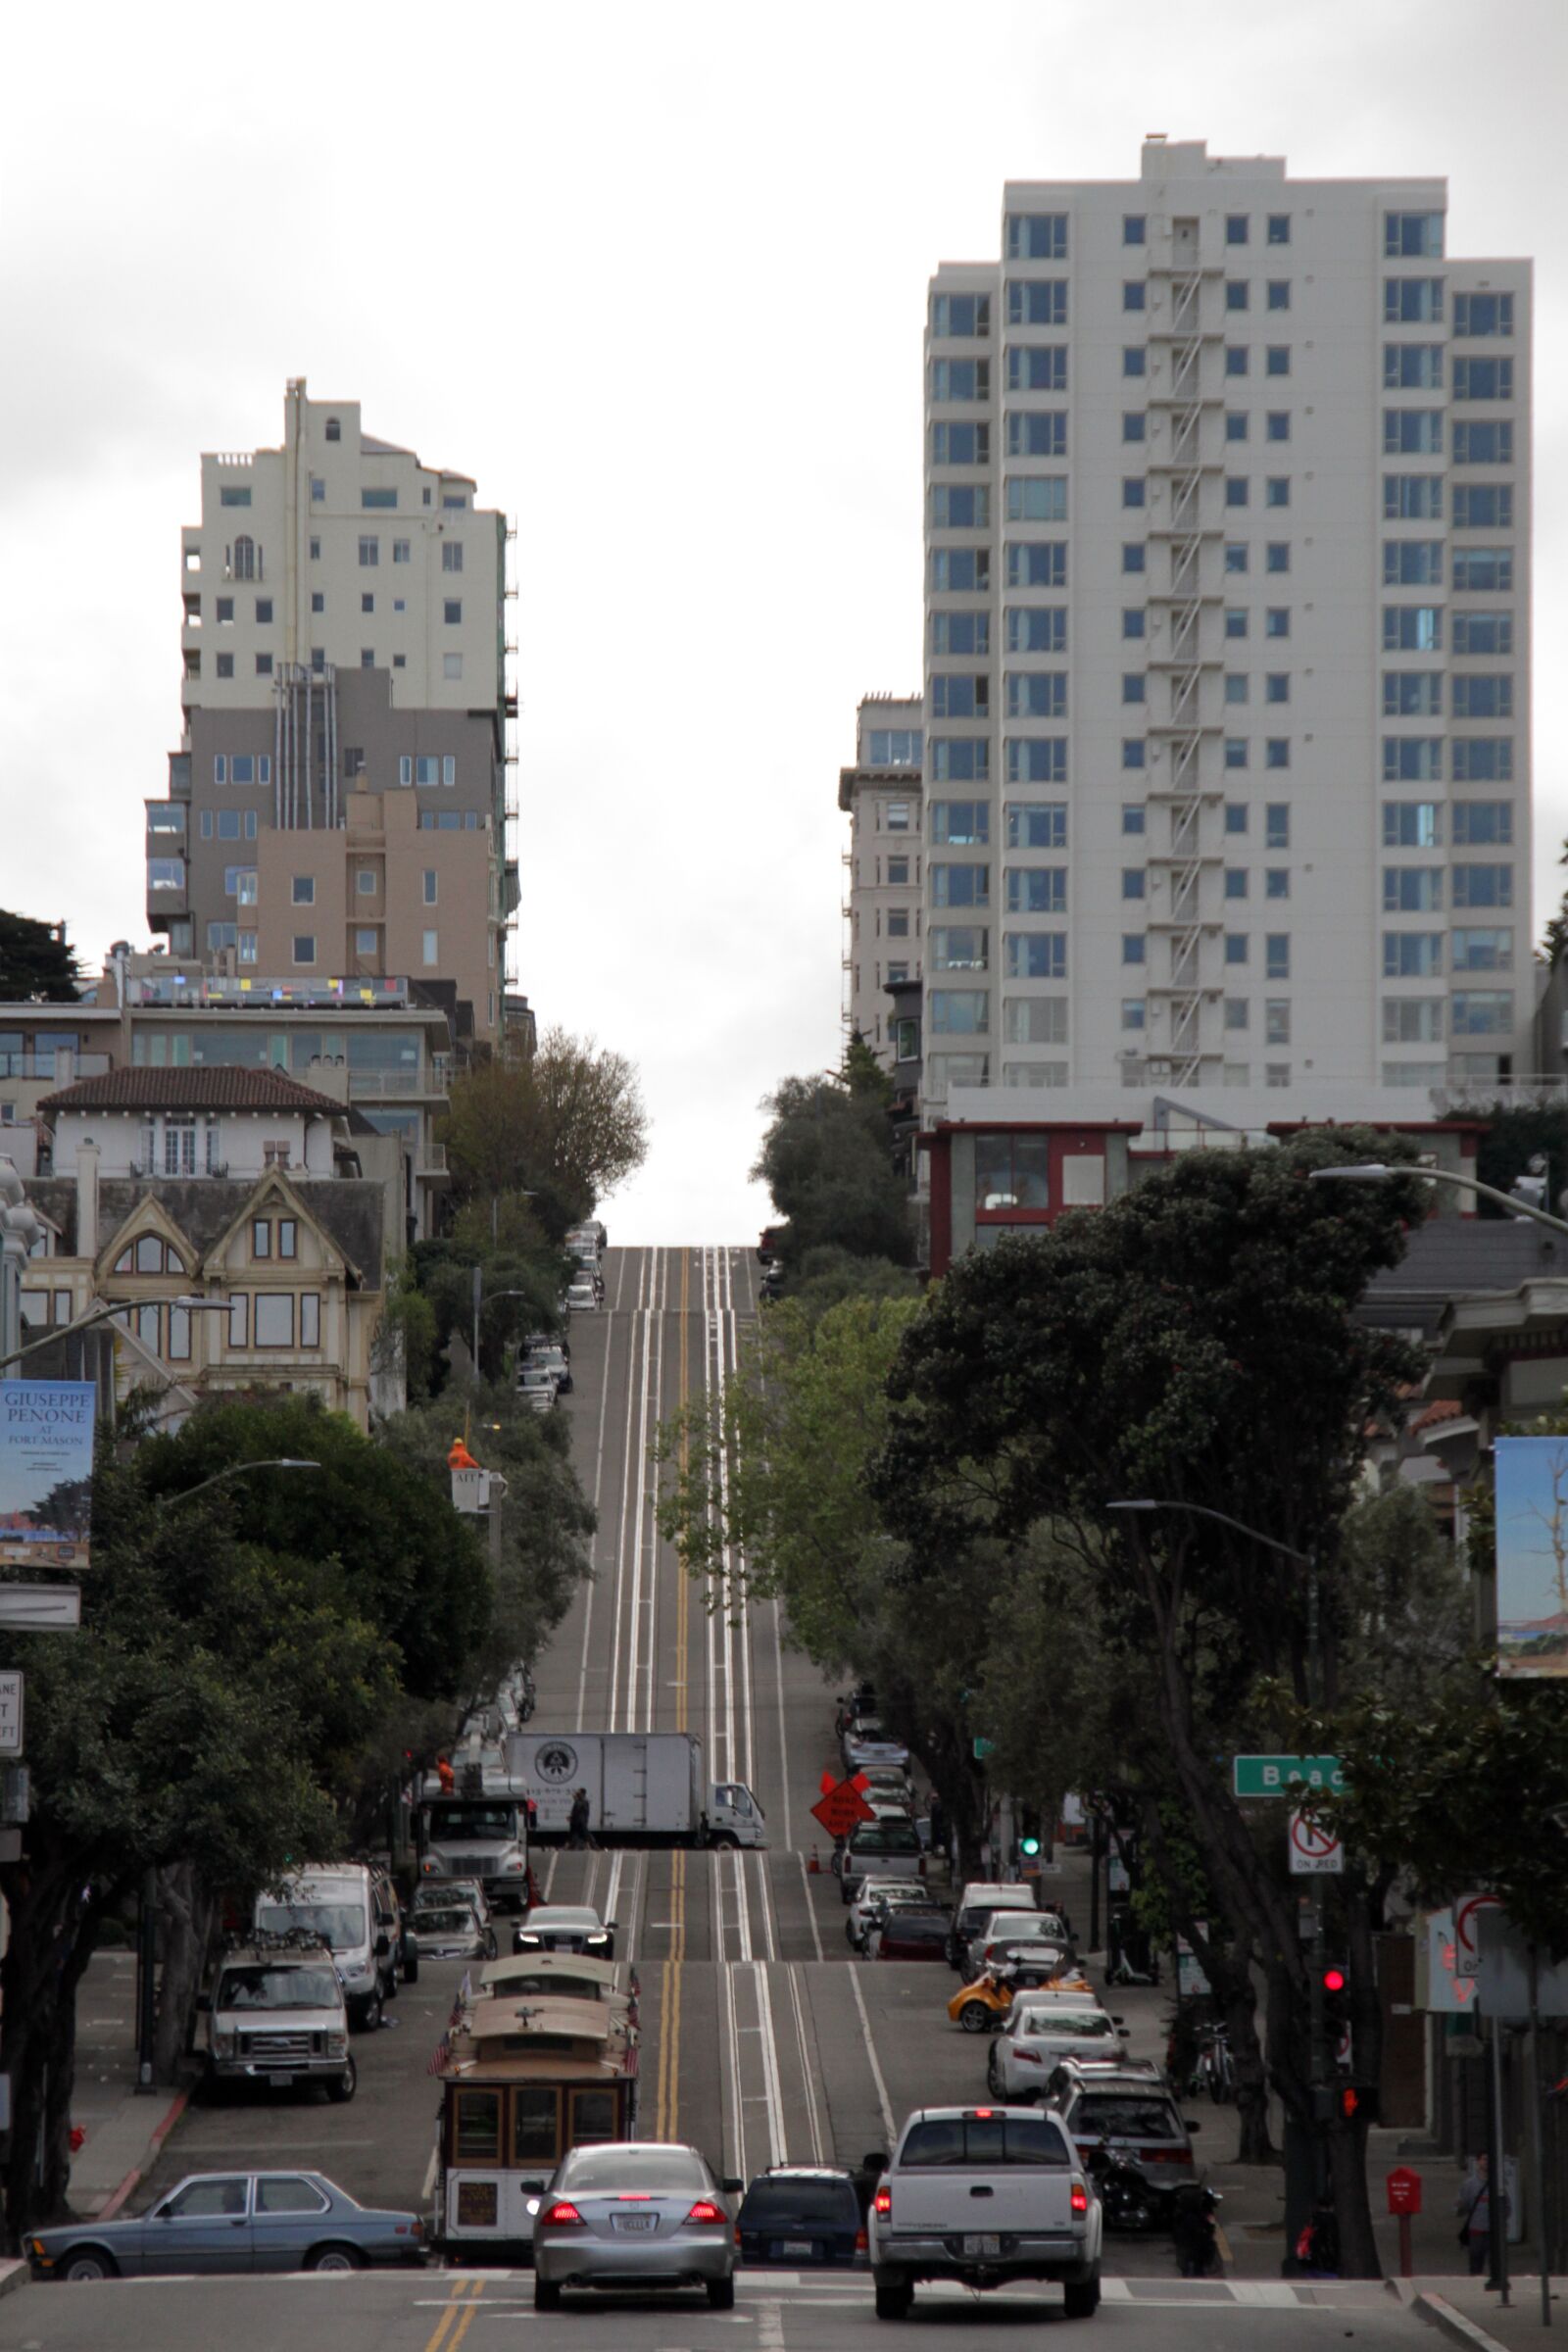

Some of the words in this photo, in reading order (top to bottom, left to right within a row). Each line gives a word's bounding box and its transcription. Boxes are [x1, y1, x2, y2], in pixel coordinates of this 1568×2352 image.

[5, 1393, 90, 1408] GIUSEPPE
[8, 1408, 86, 1424] PENONE
[39, 1426, 53, 1435] AT
[9, 1436, 38, 1445] FORT
[41, 1436, 83, 1446] MASON
[0, 1684, 17, 1695] NE
[1262, 1765, 1344, 1786] Beac
[1297, 1859, 1311, 1869] ON
[1317, 1859, 1339, 1870] RED
